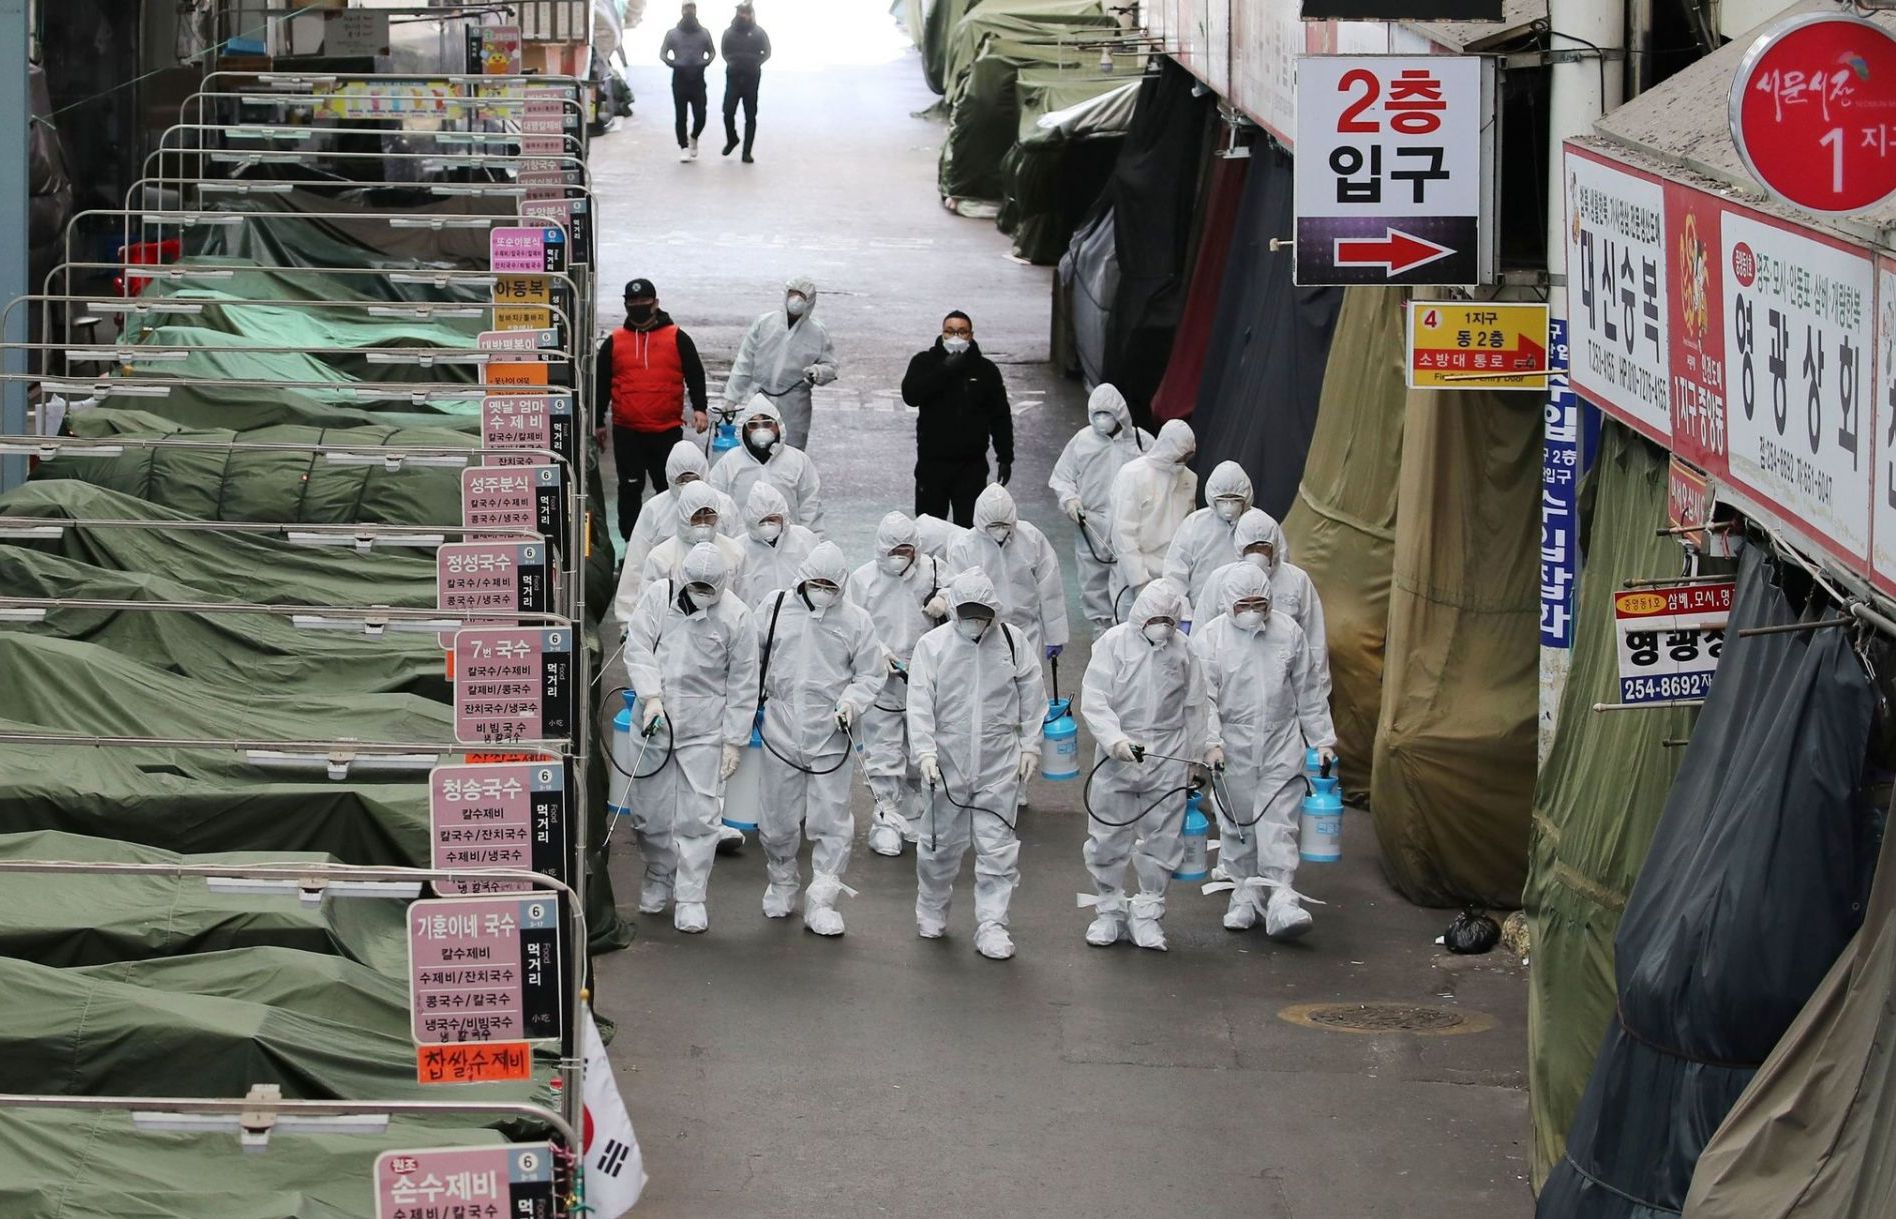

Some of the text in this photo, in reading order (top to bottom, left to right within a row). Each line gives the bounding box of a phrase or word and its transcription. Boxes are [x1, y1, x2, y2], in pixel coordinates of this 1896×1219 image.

[1337, 68, 1446, 134] 2층
[1819, 127, 1843, 192] 1
[1329, 144, 1450, 203] 입구
[496, 280, 544, 298] 아동복
[1581, 228, 1660, 364] 대신승복
[1424, 310, 1437, 327] 4
[1465, 312, 1498, 326] 1지구
[1419, 353, 1504, 368] 소방대 통로
[1735, 292, 1860, 473] 영광상회
[489, 399, 545, 414] 옛날 엄마
[1675, 375, 1724, 456] 1지구 중앙동
[553, 423, 562, 450] 먹거리
[470, 475, 529, 494] 성주분식
[471, 498, 529, 508] 칼국수/수제비
[540, 495, 550, 525] 먹거리
[447, 553, 512, 573] 정성국수
[447, 578, 511, 589] 칼국수/수제비
[523, 575, 533, 607] 먹거리
[447, 594, 511, 606] 콩국수/냉국수
[495, 639, 531, 659] 국수
[468, 665, 531, 677] 칼국수/수제비
[547, 663, 558, 698] 먹거리
[467, 684, 531, 696] 칼제비/콩국수
[465, 702, 539, 714] 잔치국수/냉국수
[541, 771, 548, 781] 6
[442, 777, 523, 801] 청송국수
[462, 807, 504, 820] 칼수제비
[536, 804, 549, 843] 먹거리
[440, 828, 528, 842] 칼국수/잔치국수
[446, 850, 523, 862] 수제비/냉국수
[532, 906, 540, 917] 6
[417, 913, 516, 940] 기훈이네 국수
[441, 947, 491, 961] 칼수제비
[527, 942, 542, 986] 먹거리
[419, 970, 514, 984] 수제비/잔치국수
[426, 993, 511, 1008] 콩국수/칼국수
[425, 1016, 513, 1032] 냉국수/비빔국수
[524, 1156, 533, 1168] 6
[391, 1170, 497, 1204] 손수제비
[393, 1203, 498, 1219] 수제비/칼국수
